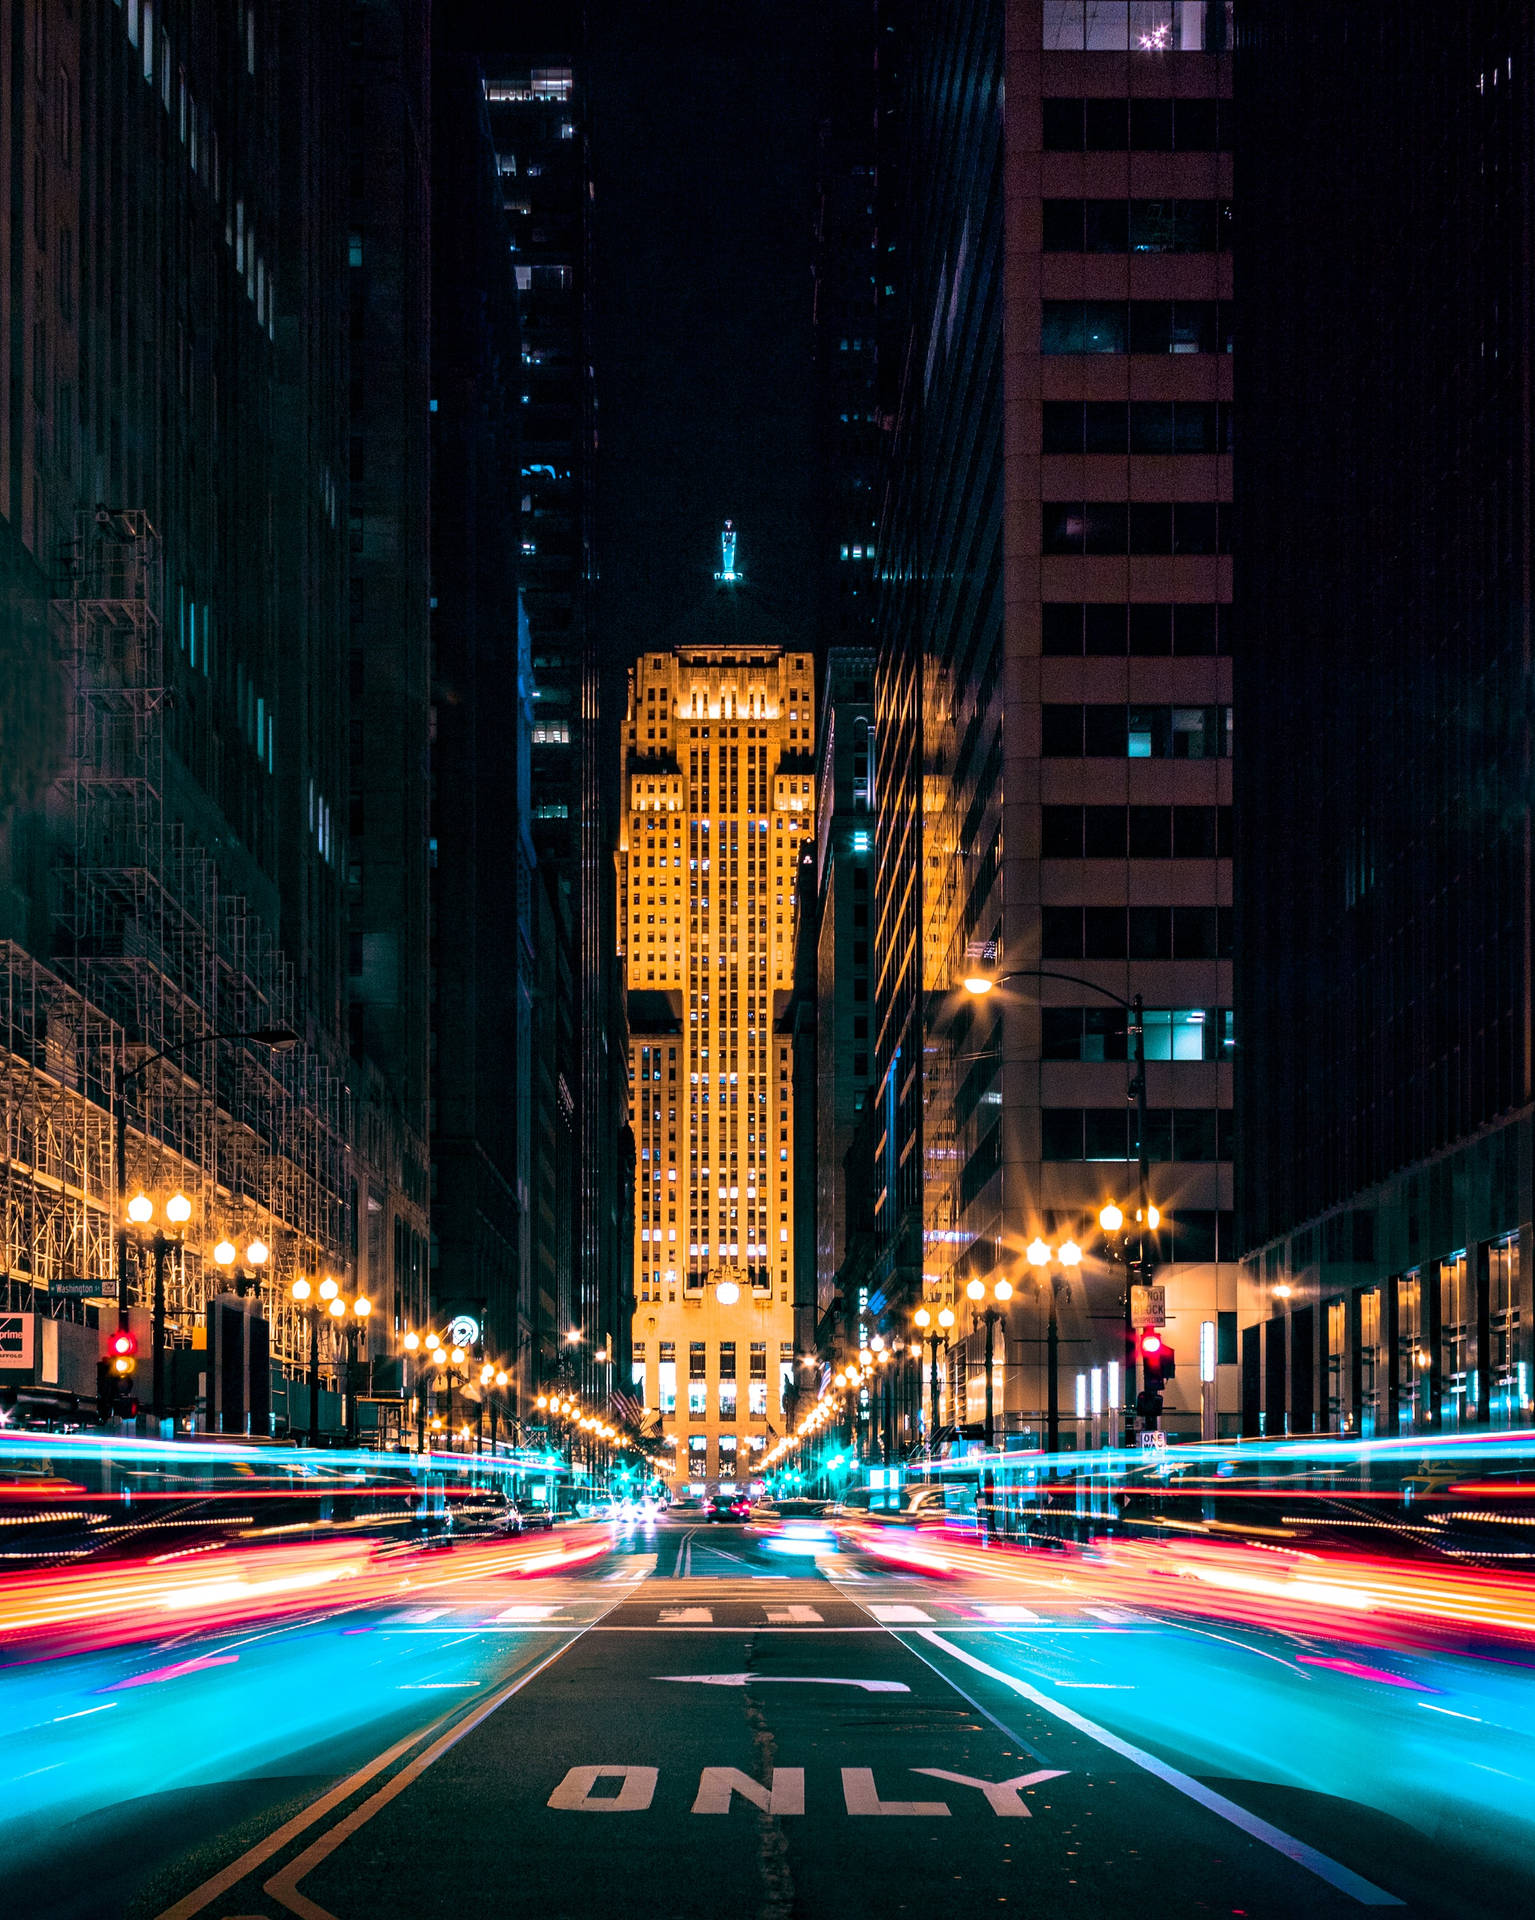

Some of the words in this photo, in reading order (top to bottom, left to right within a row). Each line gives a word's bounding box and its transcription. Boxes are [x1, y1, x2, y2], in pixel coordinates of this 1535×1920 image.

[56, 1284, 93, 1296] Washington
[1147, 1291, 1163, 1301] NOT
[1133, 1304, 1164, 1315] BLOCK
[1144, 1434, 1163, 1442] ONE
[546, 1764, 1071, 1818] ONLY
